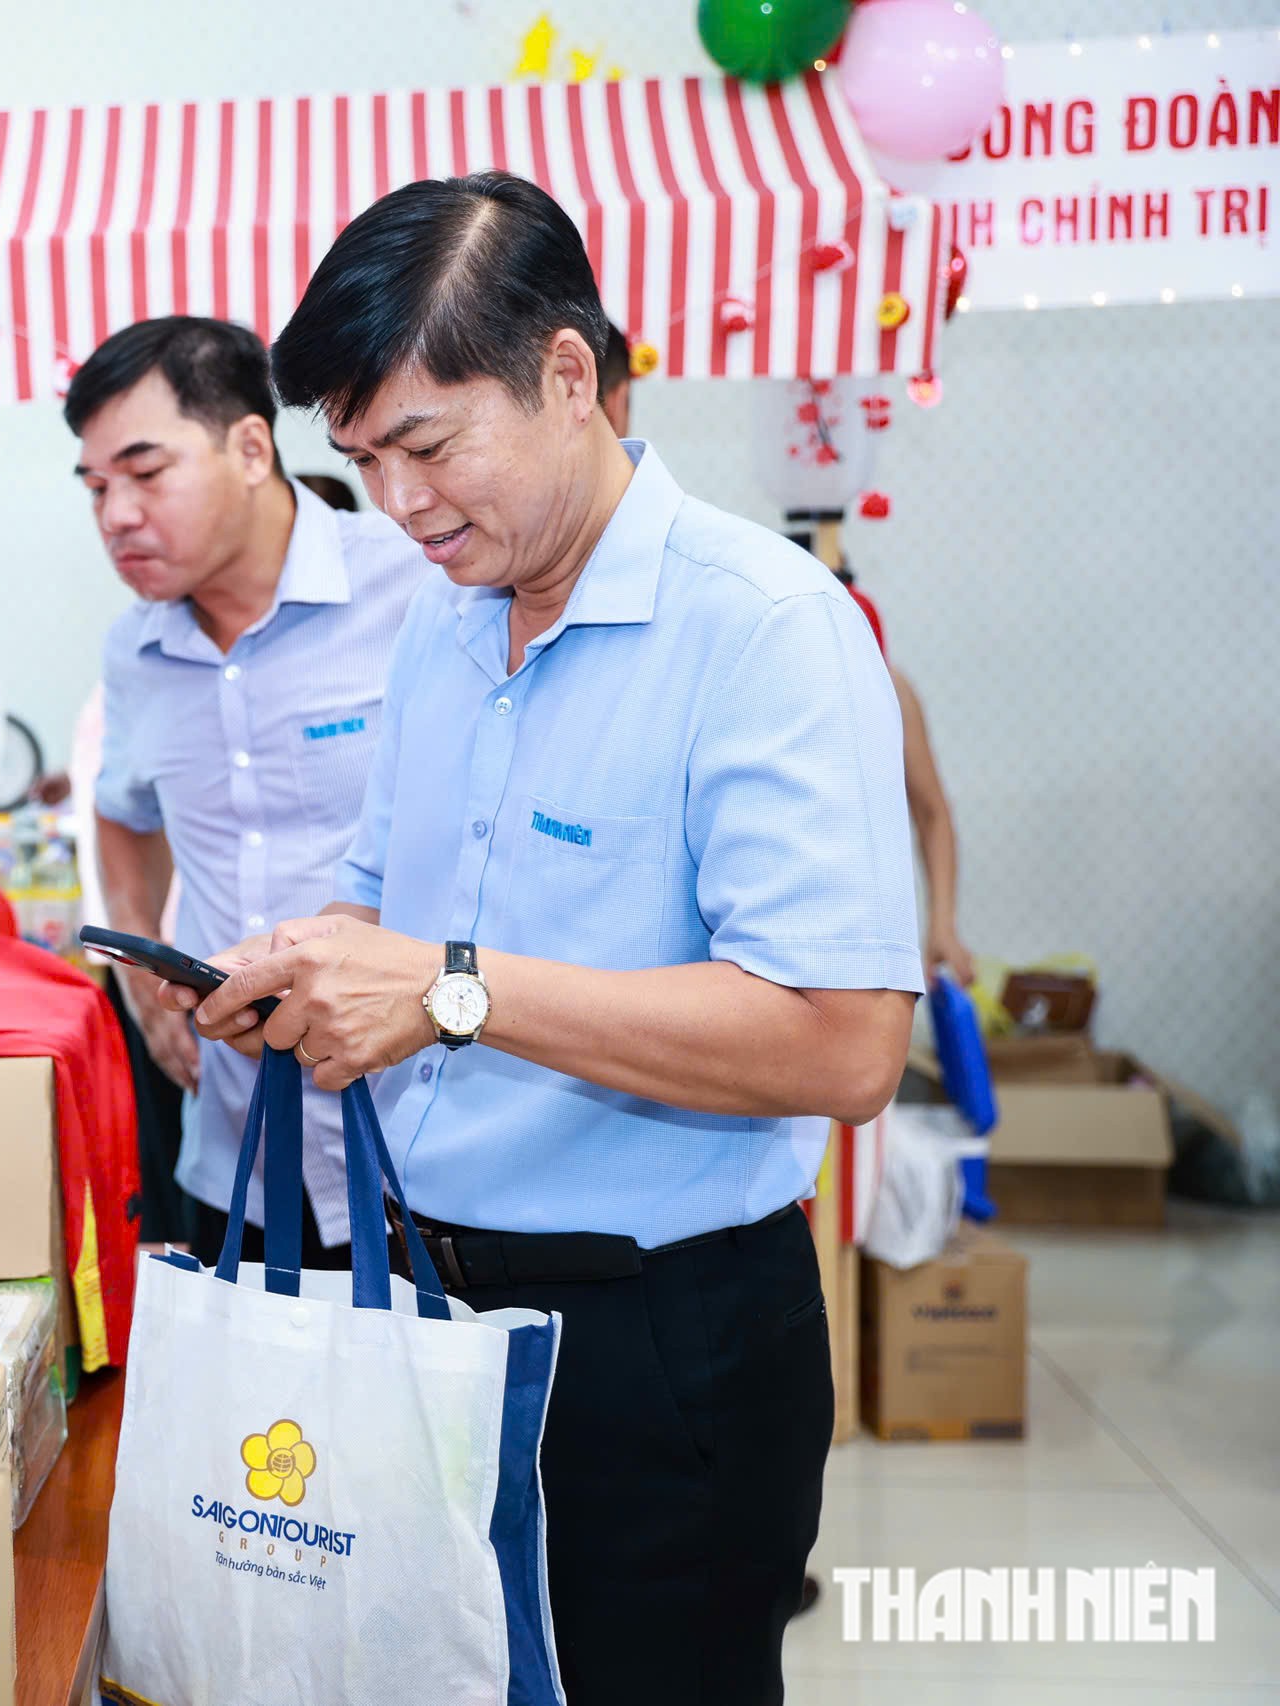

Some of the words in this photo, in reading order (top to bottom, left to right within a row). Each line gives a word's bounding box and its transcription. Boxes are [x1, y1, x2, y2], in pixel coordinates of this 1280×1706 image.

[1124, 75, 1280, 152] ĐOÀN
[1021, 182, 1169, 246] CHÍNH
[1194, 185, 1268, 248] TRỊ
[191, 1494, 356, 1556] SAIGONTOURIST
[218, 1530, 328, 1568] GROUP
[228, 1555, 264, 1577] hưởng
[288, 1570, 307, 1584] sắc
[309, 1574, 327, 1590] Việt
